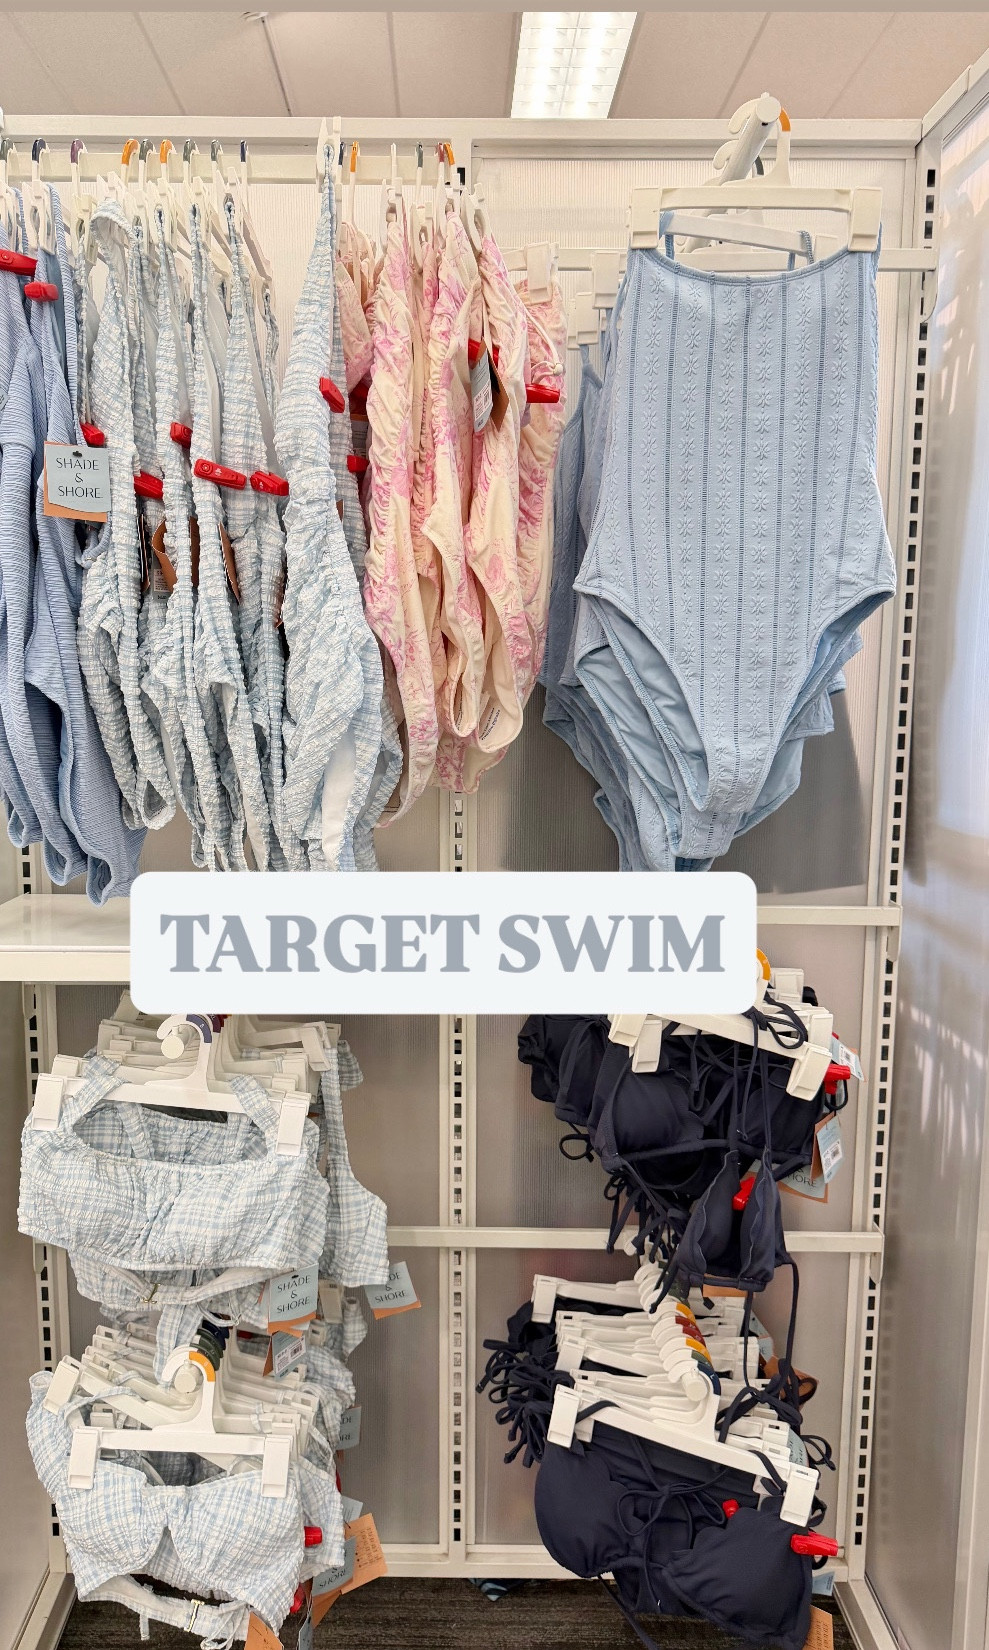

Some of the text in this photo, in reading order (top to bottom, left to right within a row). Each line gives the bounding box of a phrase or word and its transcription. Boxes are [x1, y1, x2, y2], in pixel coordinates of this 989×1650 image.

[55, 457, 100, 471] SHADE
[74, 472, 84, 483] &
[57, 485, 104, 499] SHORE
[276, 1274, 312, 1293] SHADE
[290, 1289, 298, 1299] &
[374, 1290, 406, 1304] SHORE
[276, 1295, 311, 1314] SHORE
